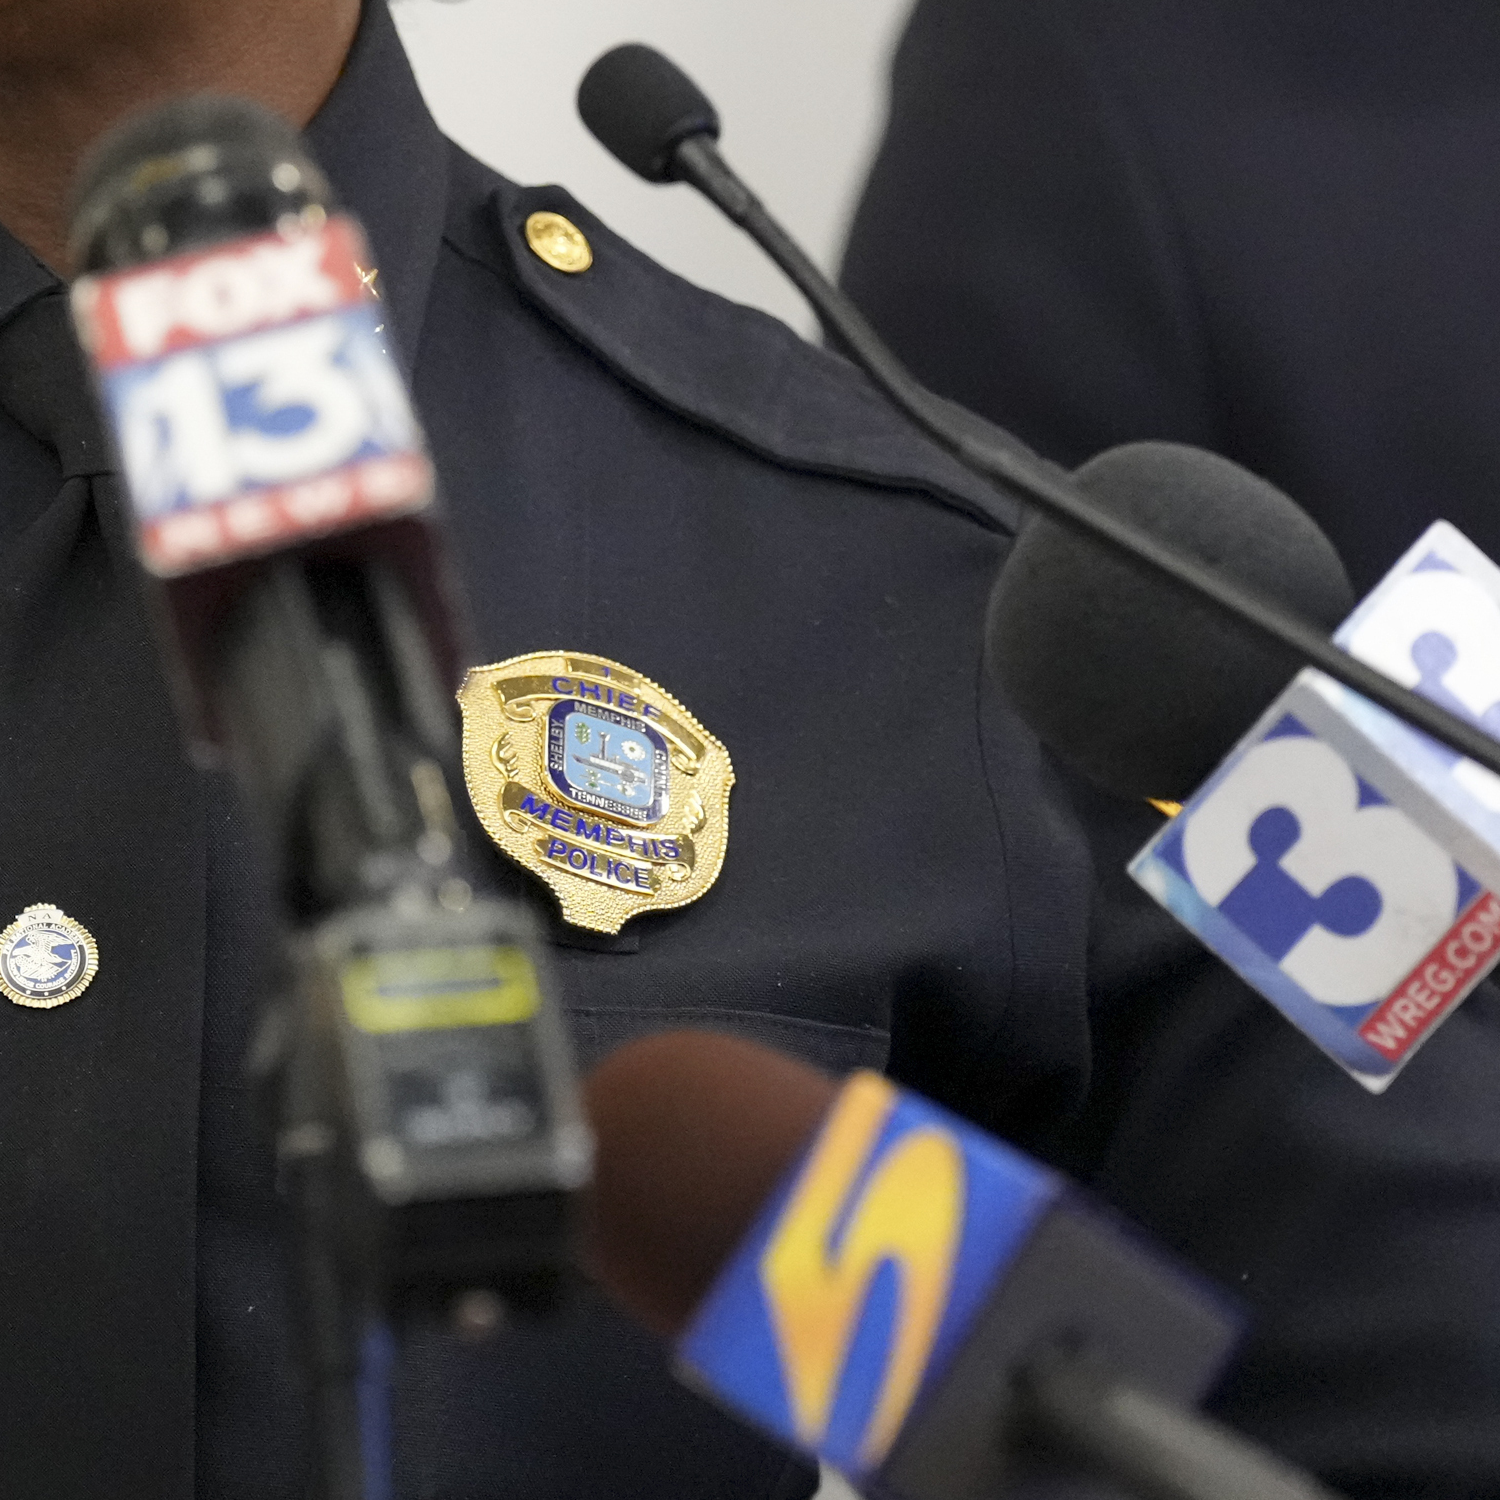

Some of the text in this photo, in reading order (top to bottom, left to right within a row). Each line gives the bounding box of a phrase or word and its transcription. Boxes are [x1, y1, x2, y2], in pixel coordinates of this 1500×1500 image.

[122, 315, 368, 499] 13
[552, 677, 662, 719] CHIEF
[573, 701, 647, 733] MEMPHIS
[550, 718, 564, 771] SHELBY
[519, 792, 681, 860] MEMPHIS
[547, 838, 652, 890] POLICE
[1182, 735, 1459, 1008] 3
